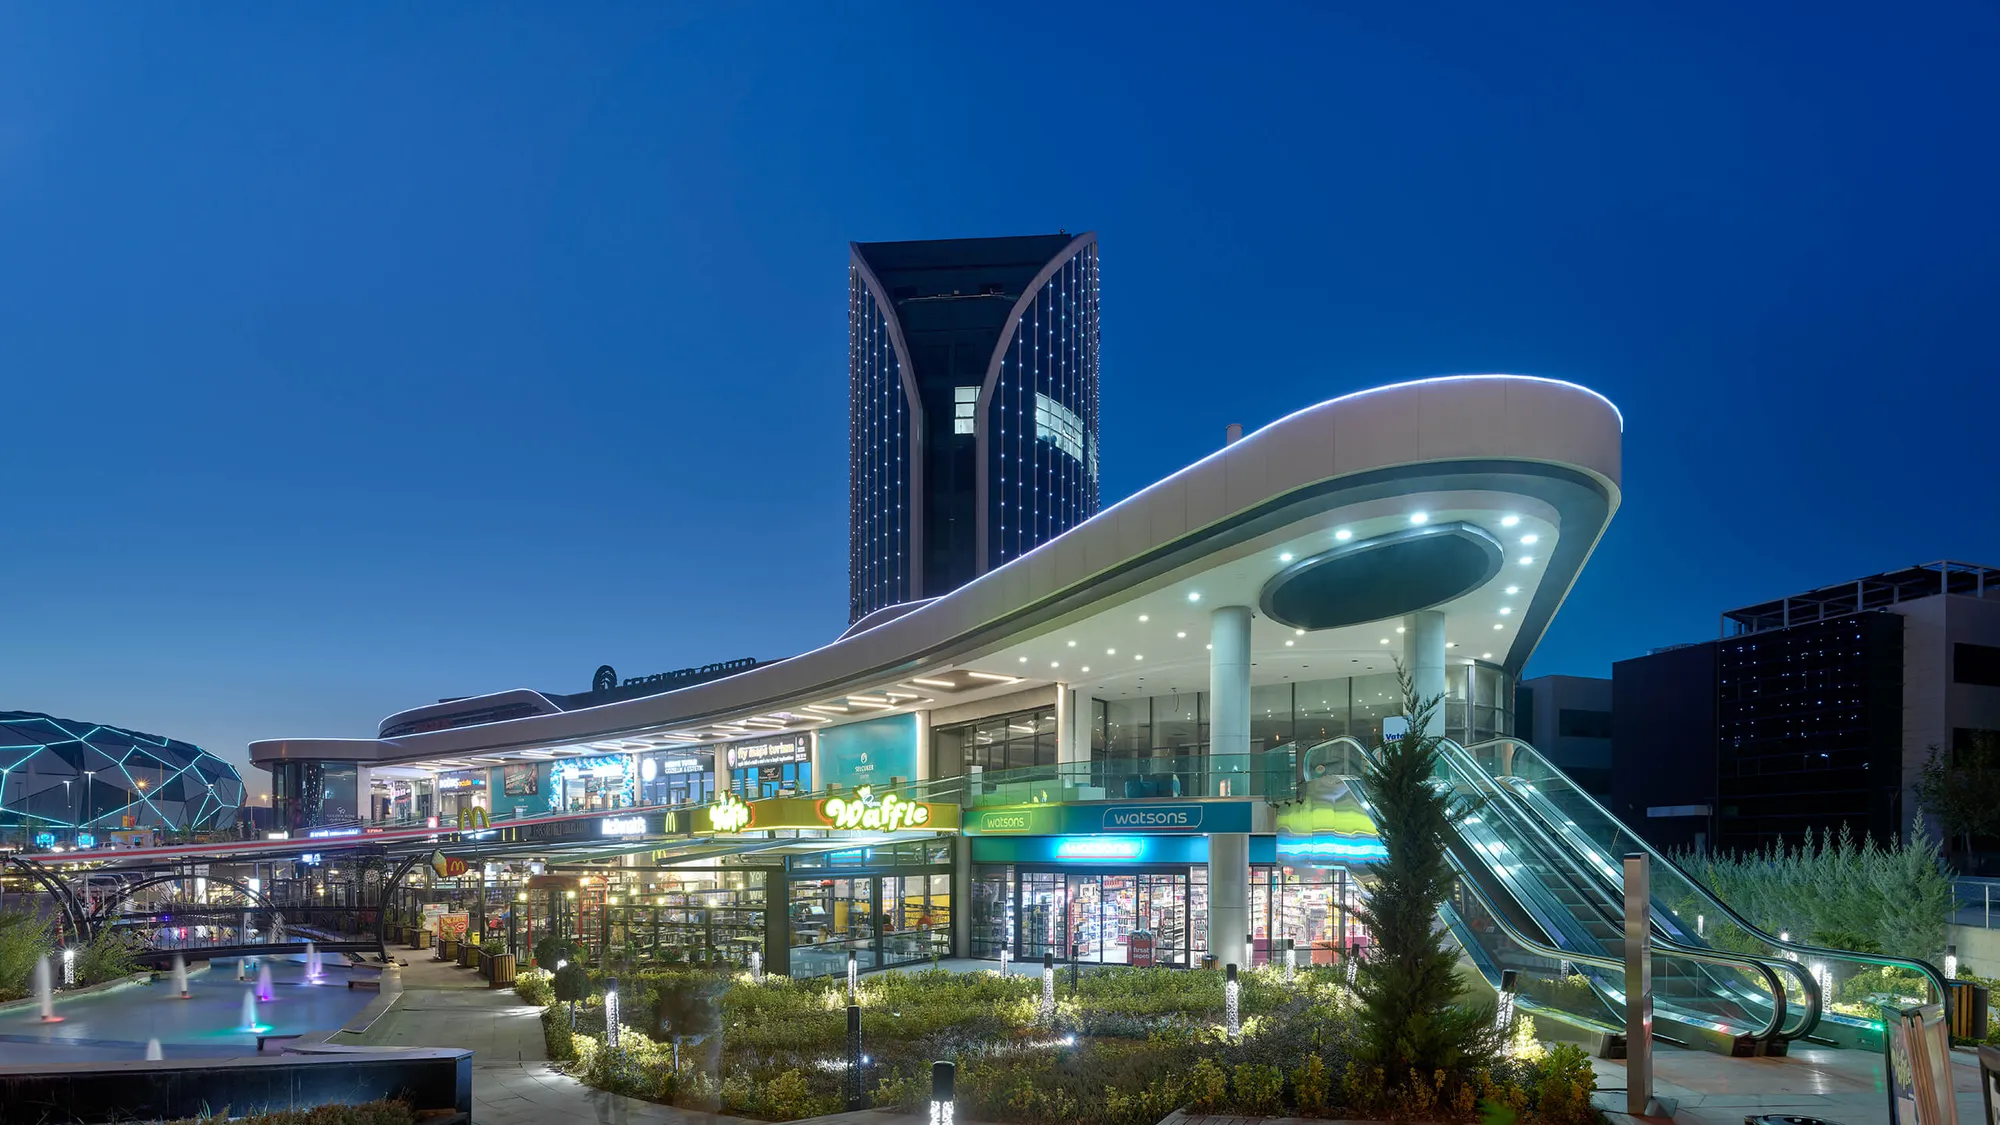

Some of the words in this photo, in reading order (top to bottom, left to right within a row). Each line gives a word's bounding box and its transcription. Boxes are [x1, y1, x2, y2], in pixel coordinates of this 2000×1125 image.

[825, 794, 929, 832] Waffle
[1114, 811, 1188, 825] watsons
[987, 817, 1025, 828] watsons
